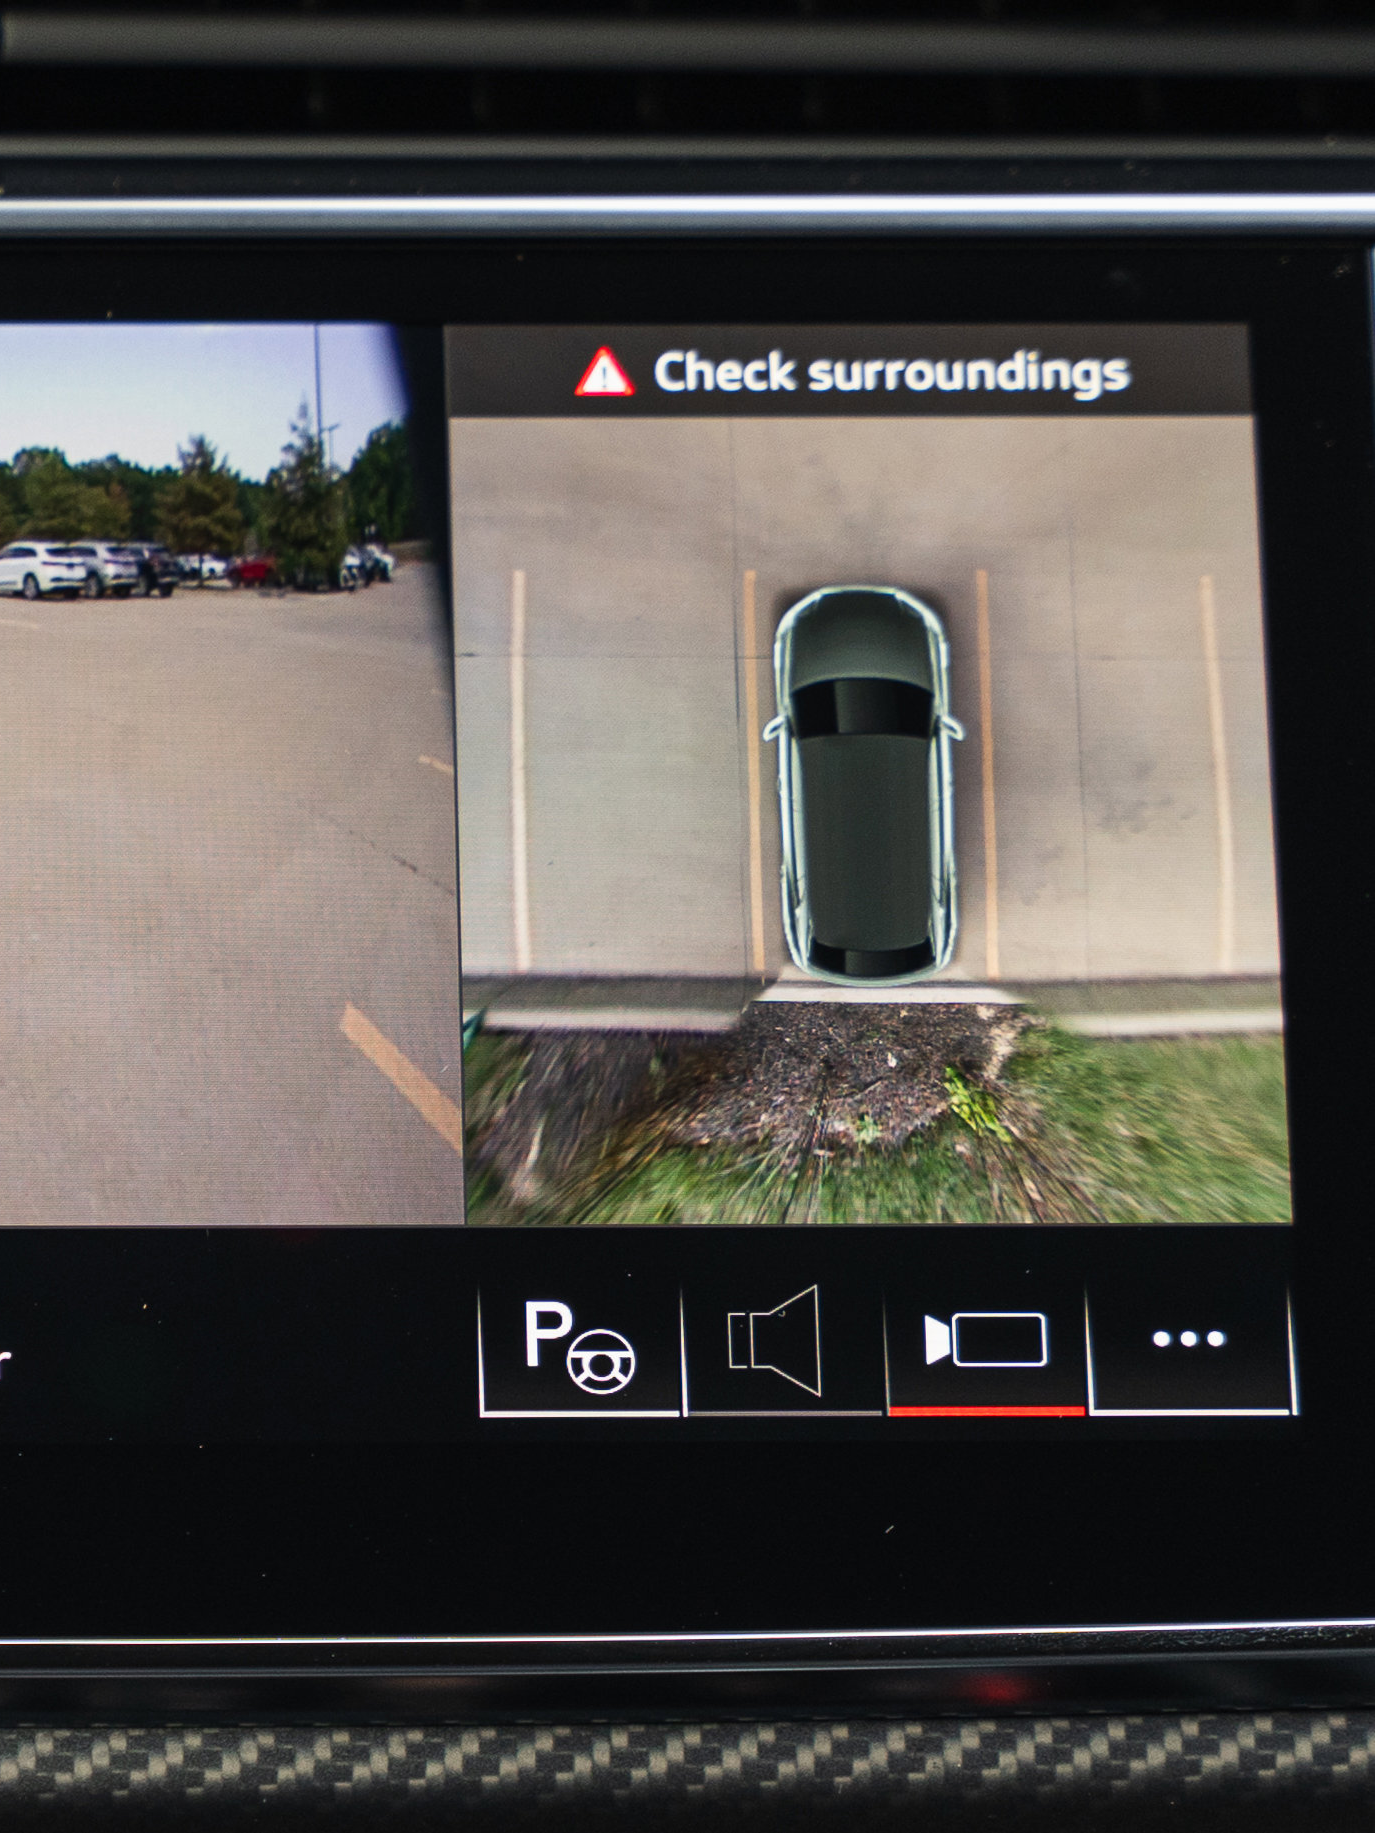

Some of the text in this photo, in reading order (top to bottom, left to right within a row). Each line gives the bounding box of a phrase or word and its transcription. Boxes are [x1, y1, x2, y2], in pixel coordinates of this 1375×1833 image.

[653, 350, 1130, 402] Check surroundings
[525, 1301, 573, 1367] P
